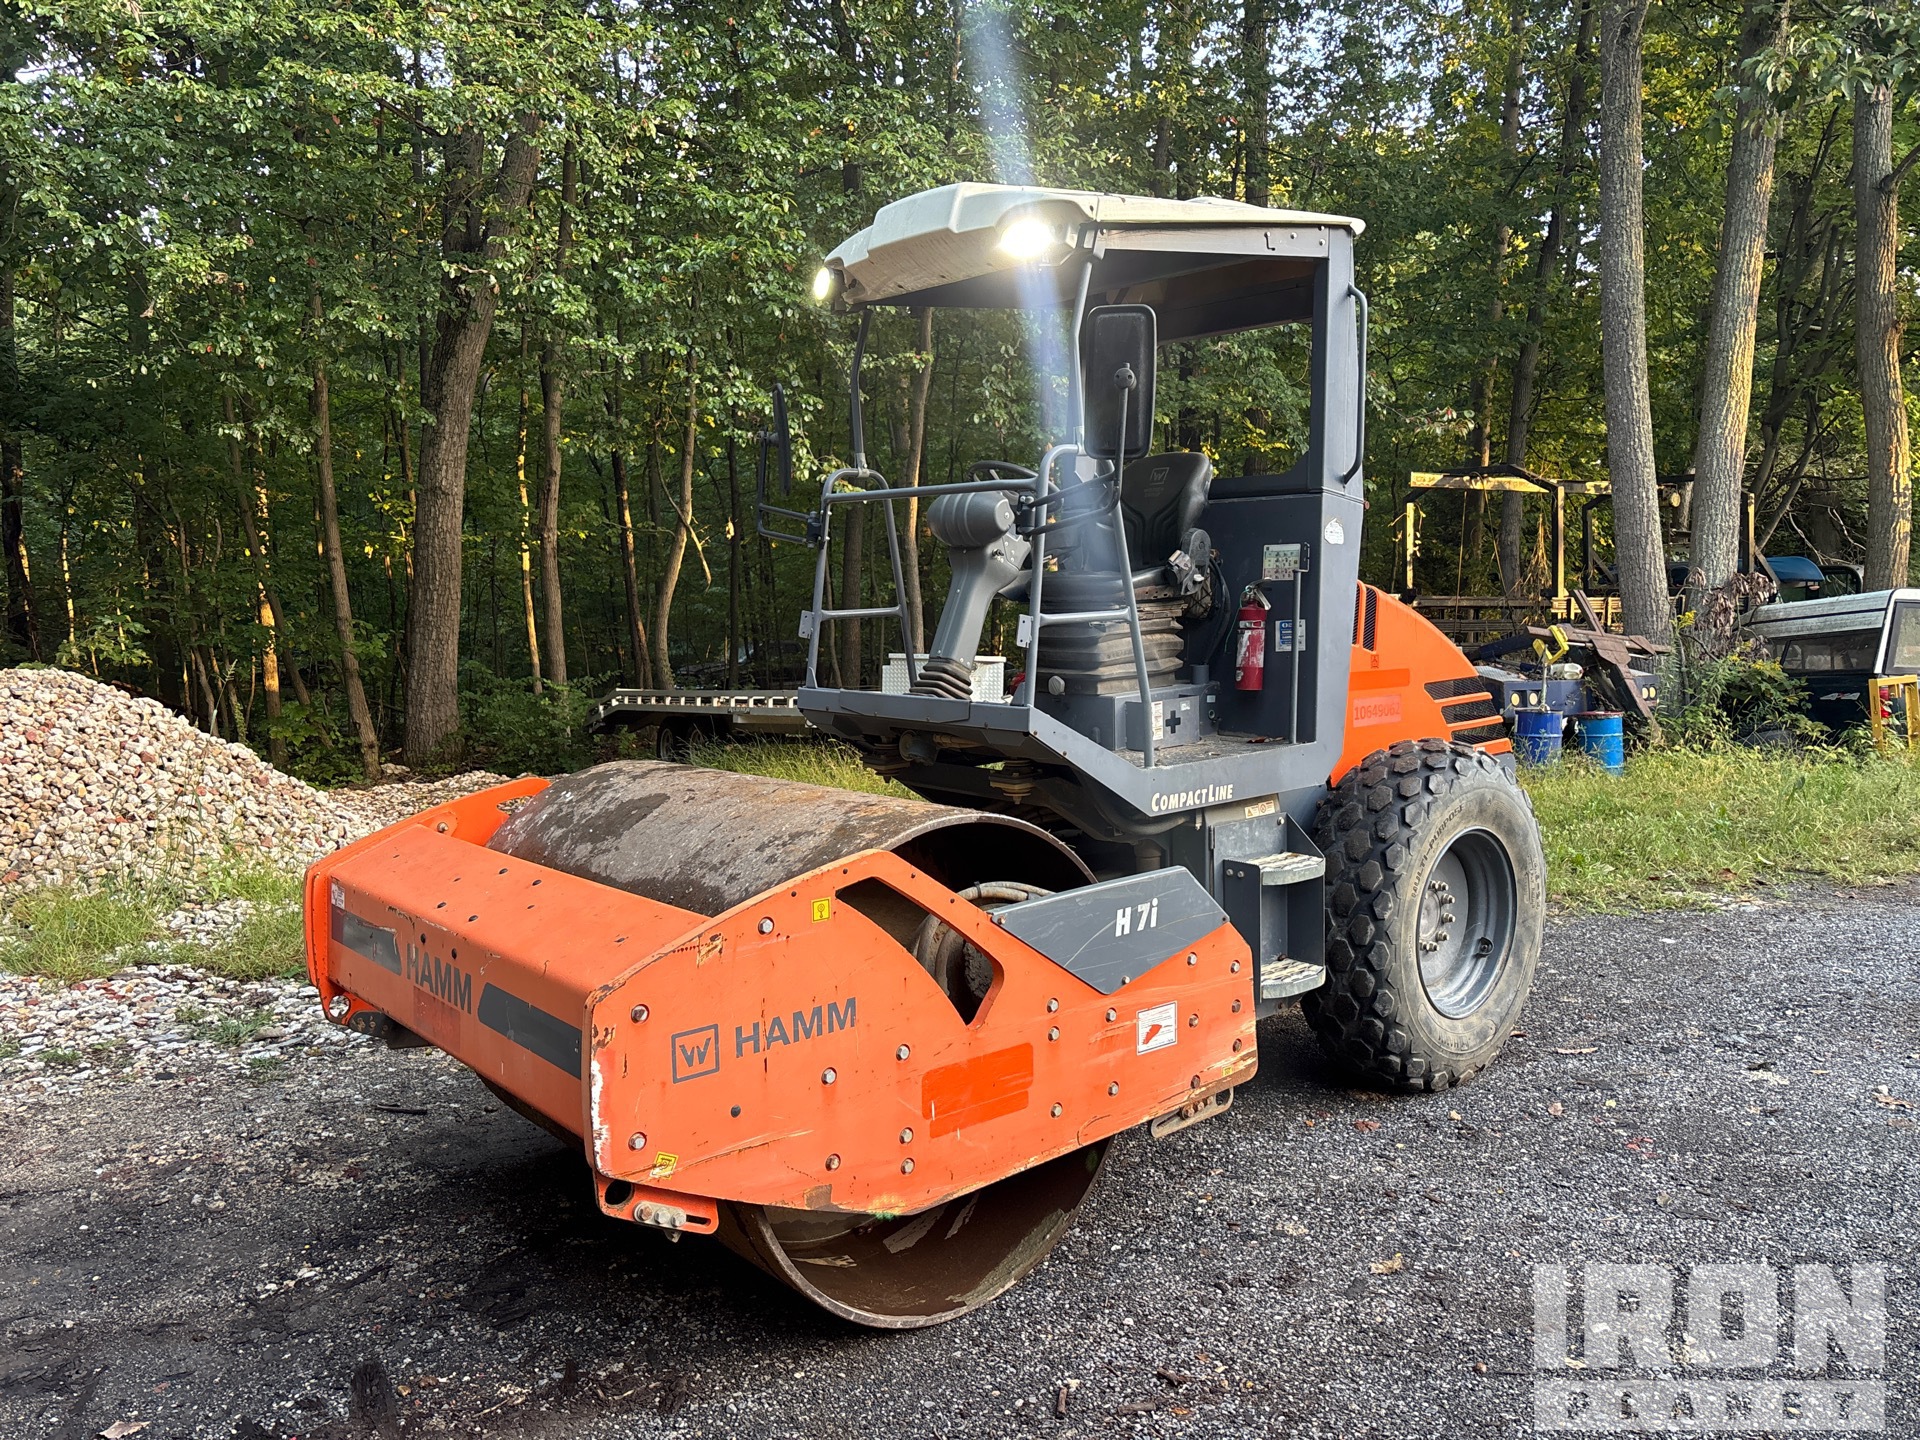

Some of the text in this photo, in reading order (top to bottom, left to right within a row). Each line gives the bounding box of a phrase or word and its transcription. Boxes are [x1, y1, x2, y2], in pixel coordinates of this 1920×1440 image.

[1354, 702, 1401, 720] 10649062
[1115, 906, 1132, 937] H
[406, 943, 473, 1015] HAMM
[735, 996, 857, 1059] HAMM
